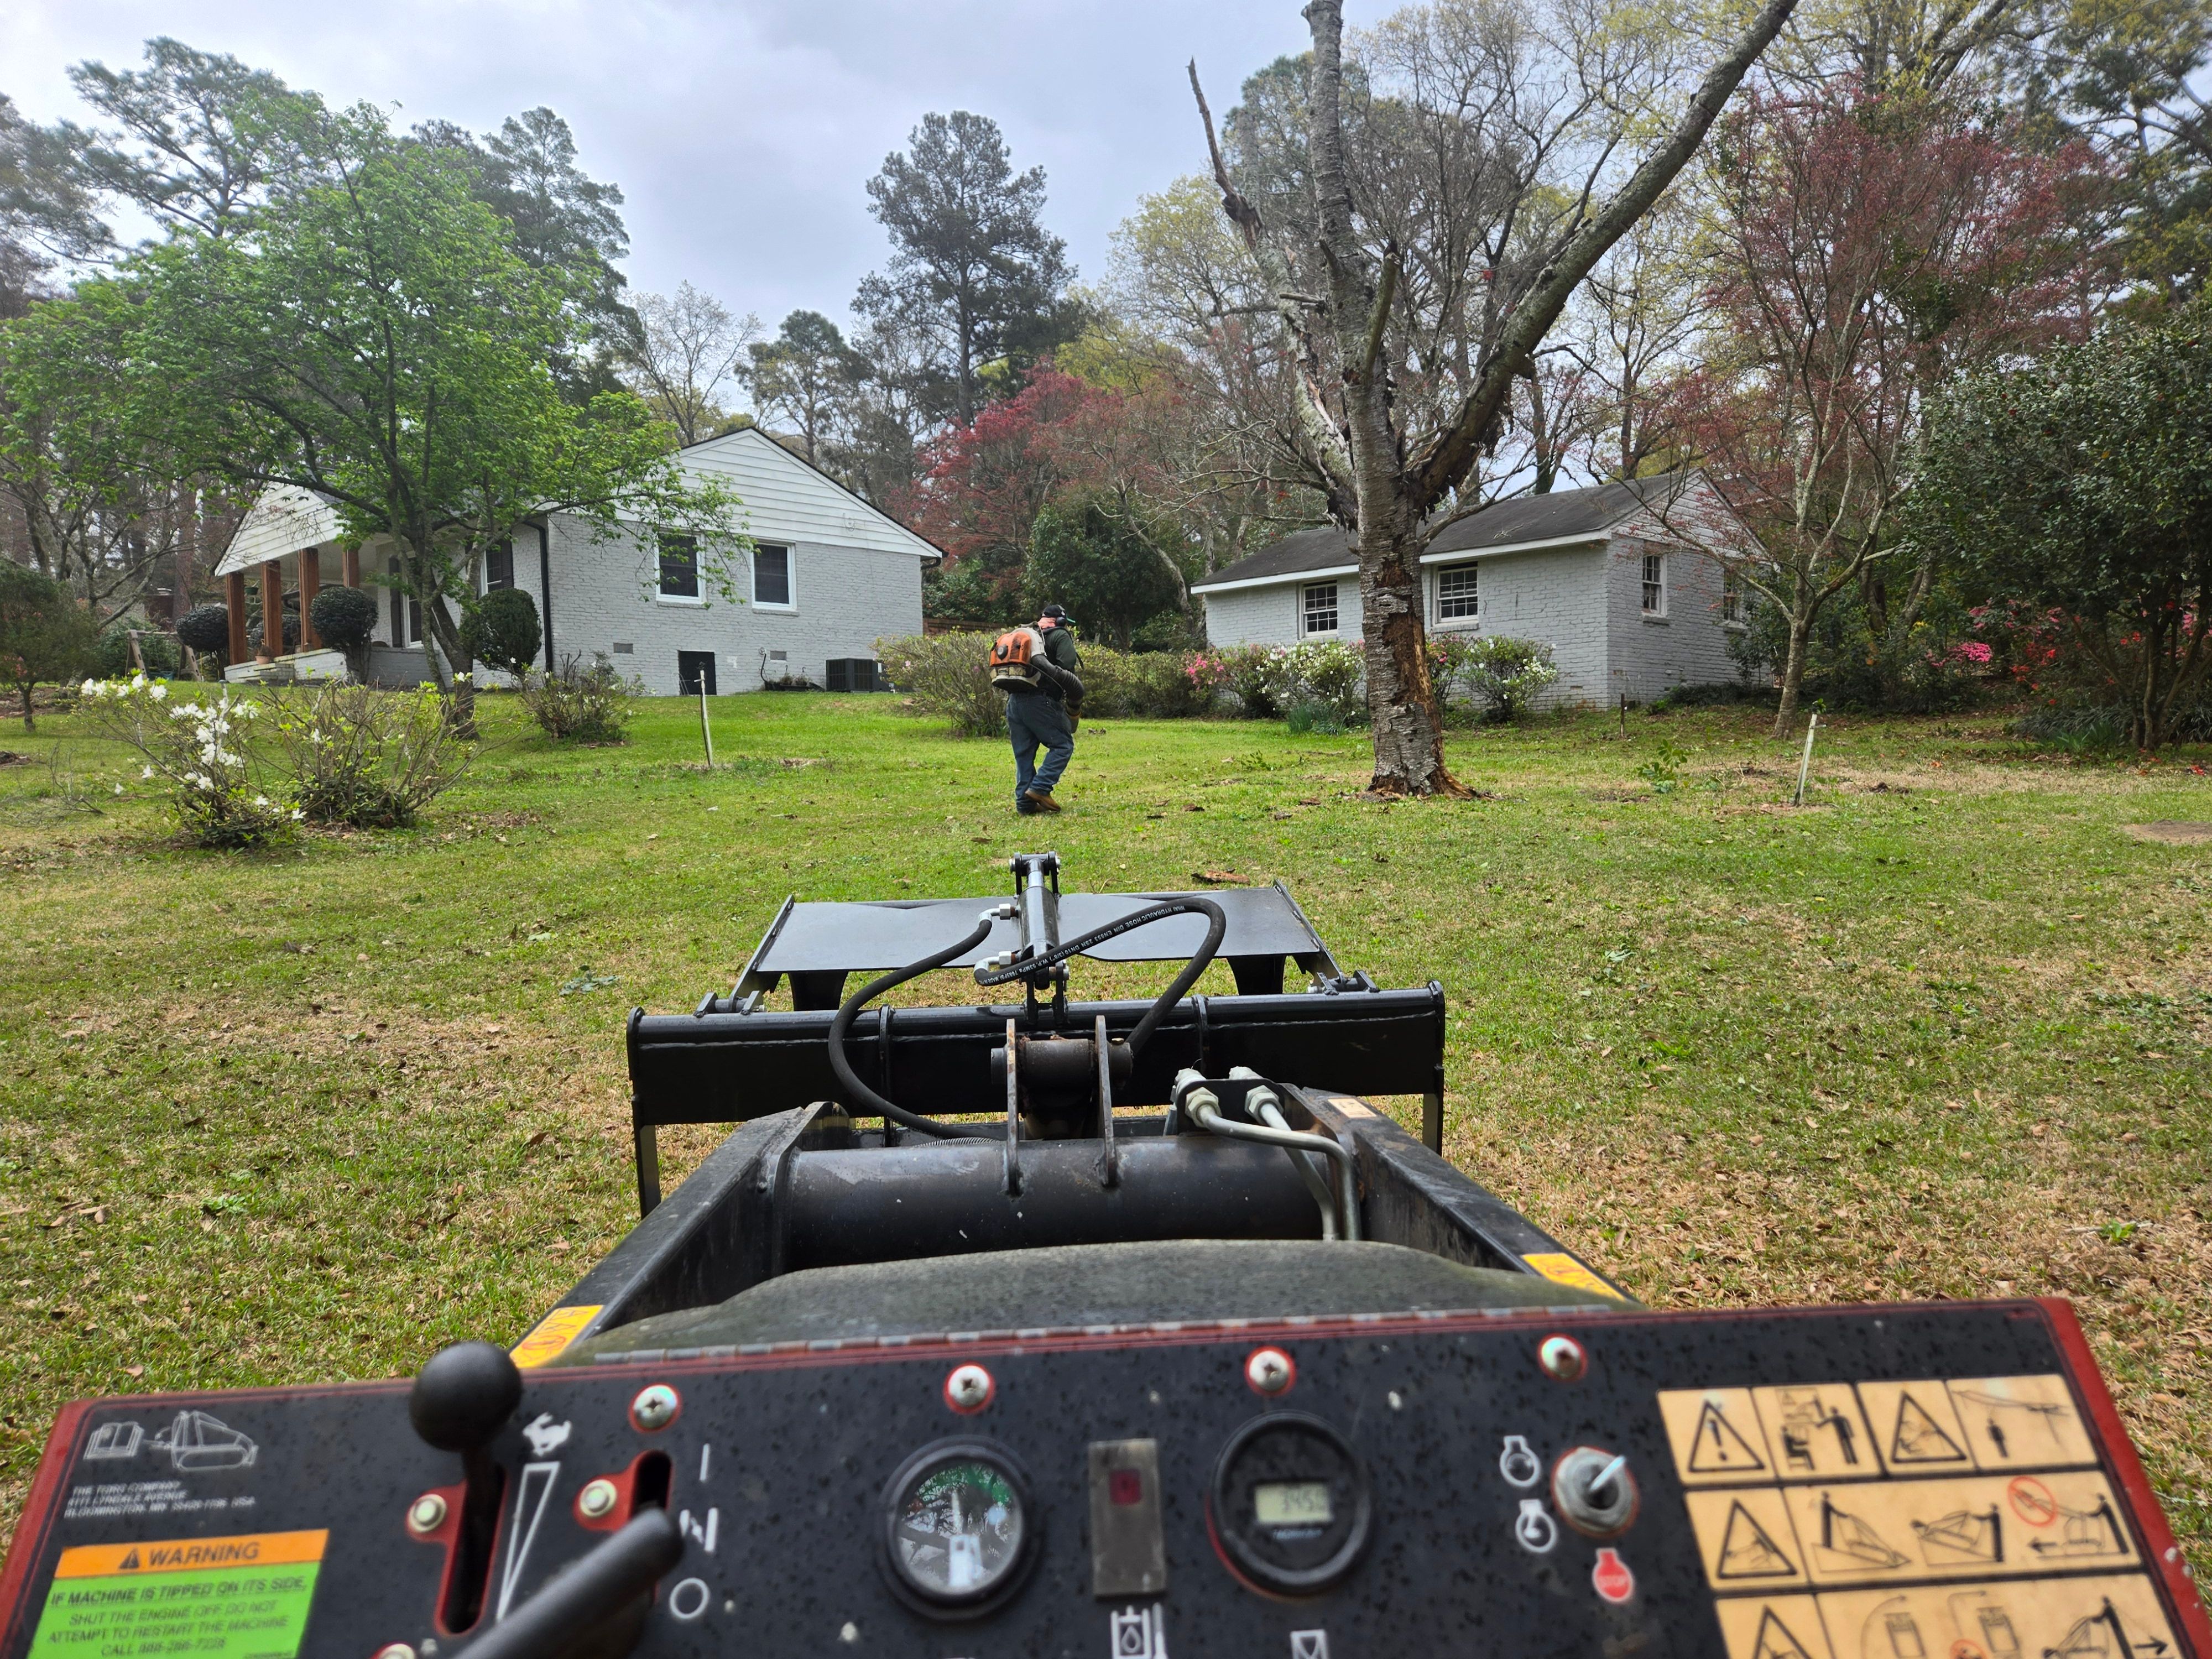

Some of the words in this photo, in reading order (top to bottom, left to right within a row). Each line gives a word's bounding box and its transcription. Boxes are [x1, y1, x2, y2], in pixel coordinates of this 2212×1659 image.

[1142, 907, 1172, 921] HYDRAULIC
[1113, 925, 1124, 933] DIN
[1125, 917, 1142, 928] HOSE
[1081, 939, 1093, 948] 2SN
[1094, 931, 1113, 942] EN853
[149, 1543, 260, 1566] WARNING
[51, 1593, 66, 1605] IF
[67, 1587, 135, 1605] MACHINE
[140, 1589, 155, 1601] IS
[159, 1582, 213, 1600] TIPPED
[217, 1580, 239, 1594] ON
[243, 1578, 266, 1592] ITS
[69, 1613, 105, 1626] SHUT
[111, 1611, 133, 1623] THE
[138, 1606, 190, 1622] ENGINE
[249, 1600, 276, 1613] NOT
[48, 1629, 107, 1644] ATTEMPT
[112, 1626, 129, 1640] TO
[132, 1622, 195, 1637] RESTART
[198, 1619, 223, 1632] THE
[227, 1616, 289, 1632] MACHINE
[101, 1642, 134, 1657] CALL
